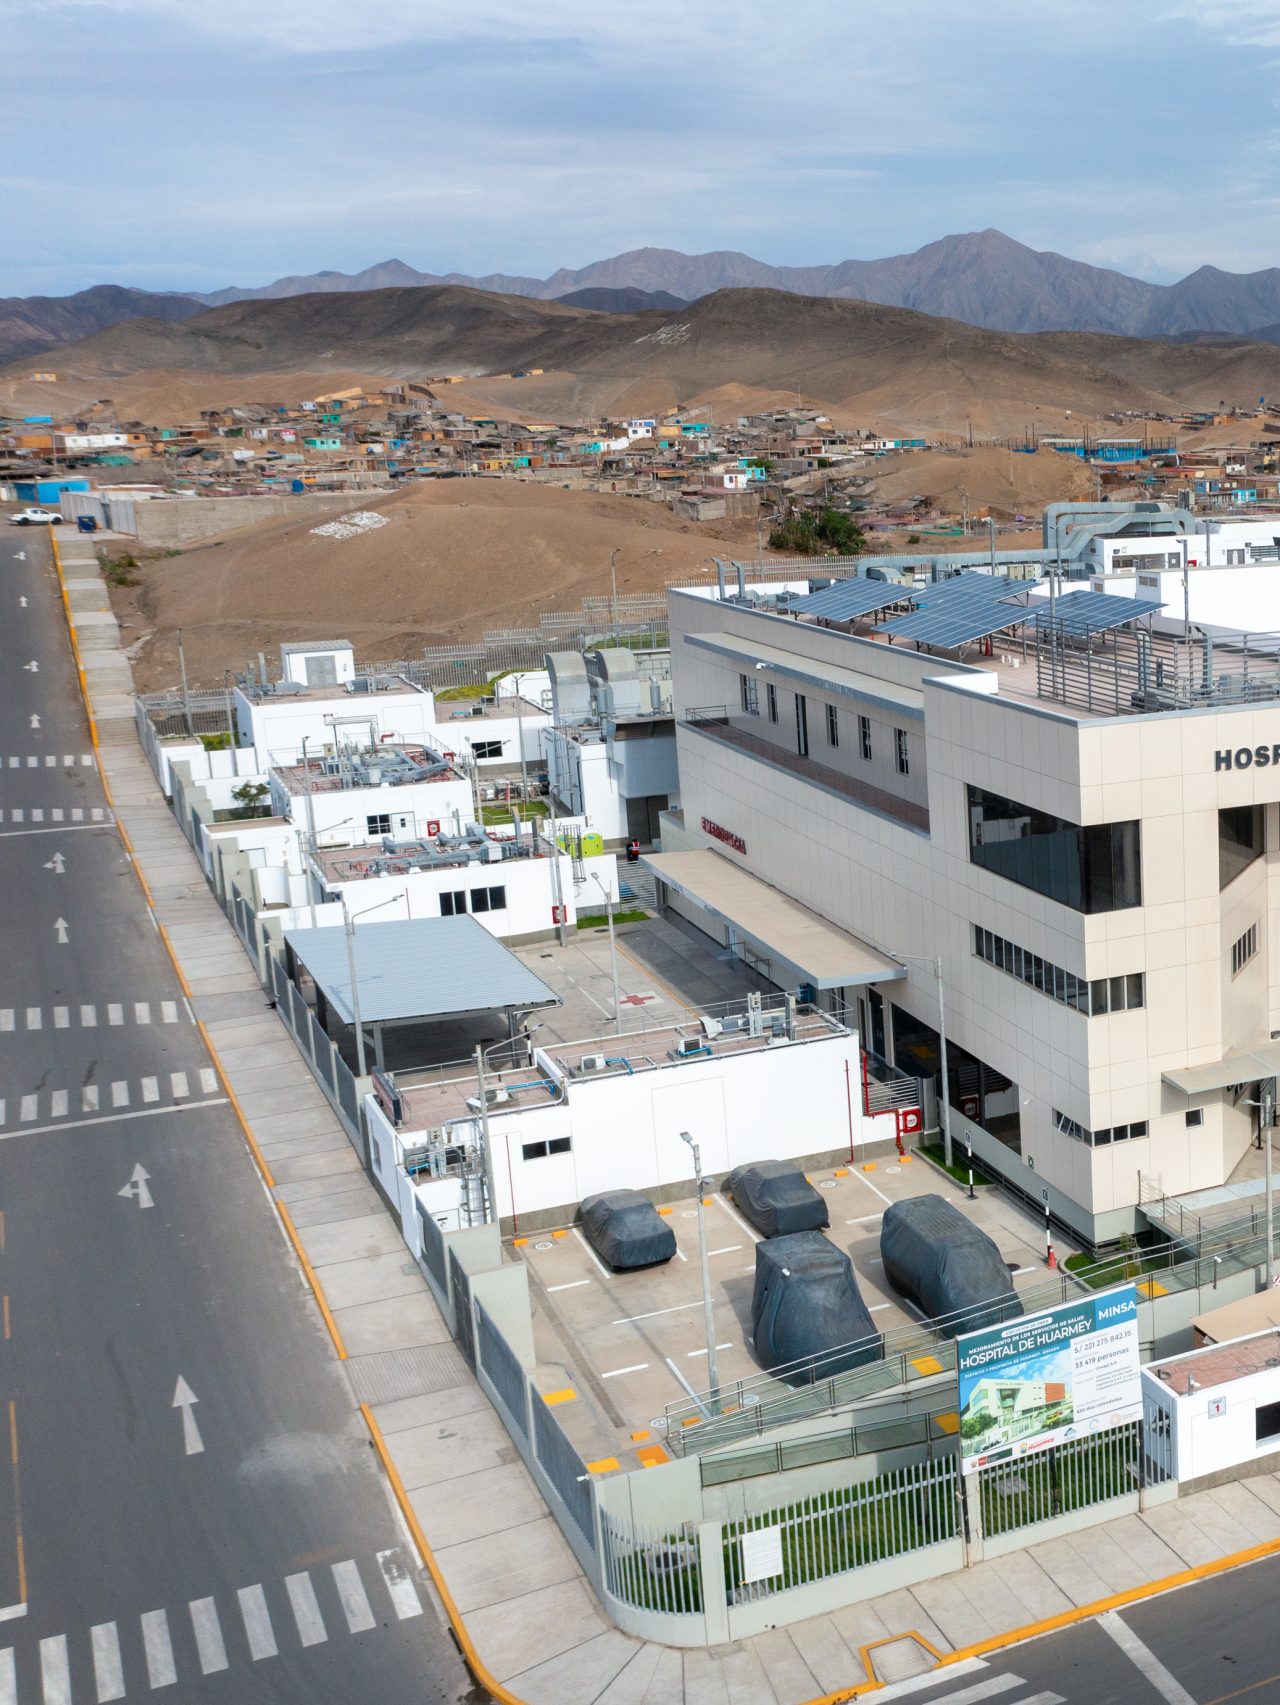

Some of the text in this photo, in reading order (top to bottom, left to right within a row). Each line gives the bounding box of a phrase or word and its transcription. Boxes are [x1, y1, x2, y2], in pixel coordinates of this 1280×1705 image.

[701, 816, 747, 856] EMERGENCIA
[1098, 1300, 1137, 1320] MINSA
[960, 1344, 1018, 1369] HOSPITAL
[1019, 1337, 1035, 1352] DE
[1037, 1318, 1092, 1346] HUARMEY
[969, 1336, 1011, 1355] MEJORAMIENTO
[1020, 1331, 1031, 1339] LOS
[1032, 1323, 1059, 1334] SERVICIOS
[1067, 1315, 1085, 1324] SALUD
[1084, 1342, 1095, 1350] 221
[1096, 1337, 1108, 1346] 275
[1109, 1330, 1132, 1342] 842.15
[1084, 1357, 1096, 1365] 419
[1097, 1348, 1129, 1363] personas
[1215, 1403, 1220, 1413] 1
[1028, 1436, 1056, 1451] Huarmey
